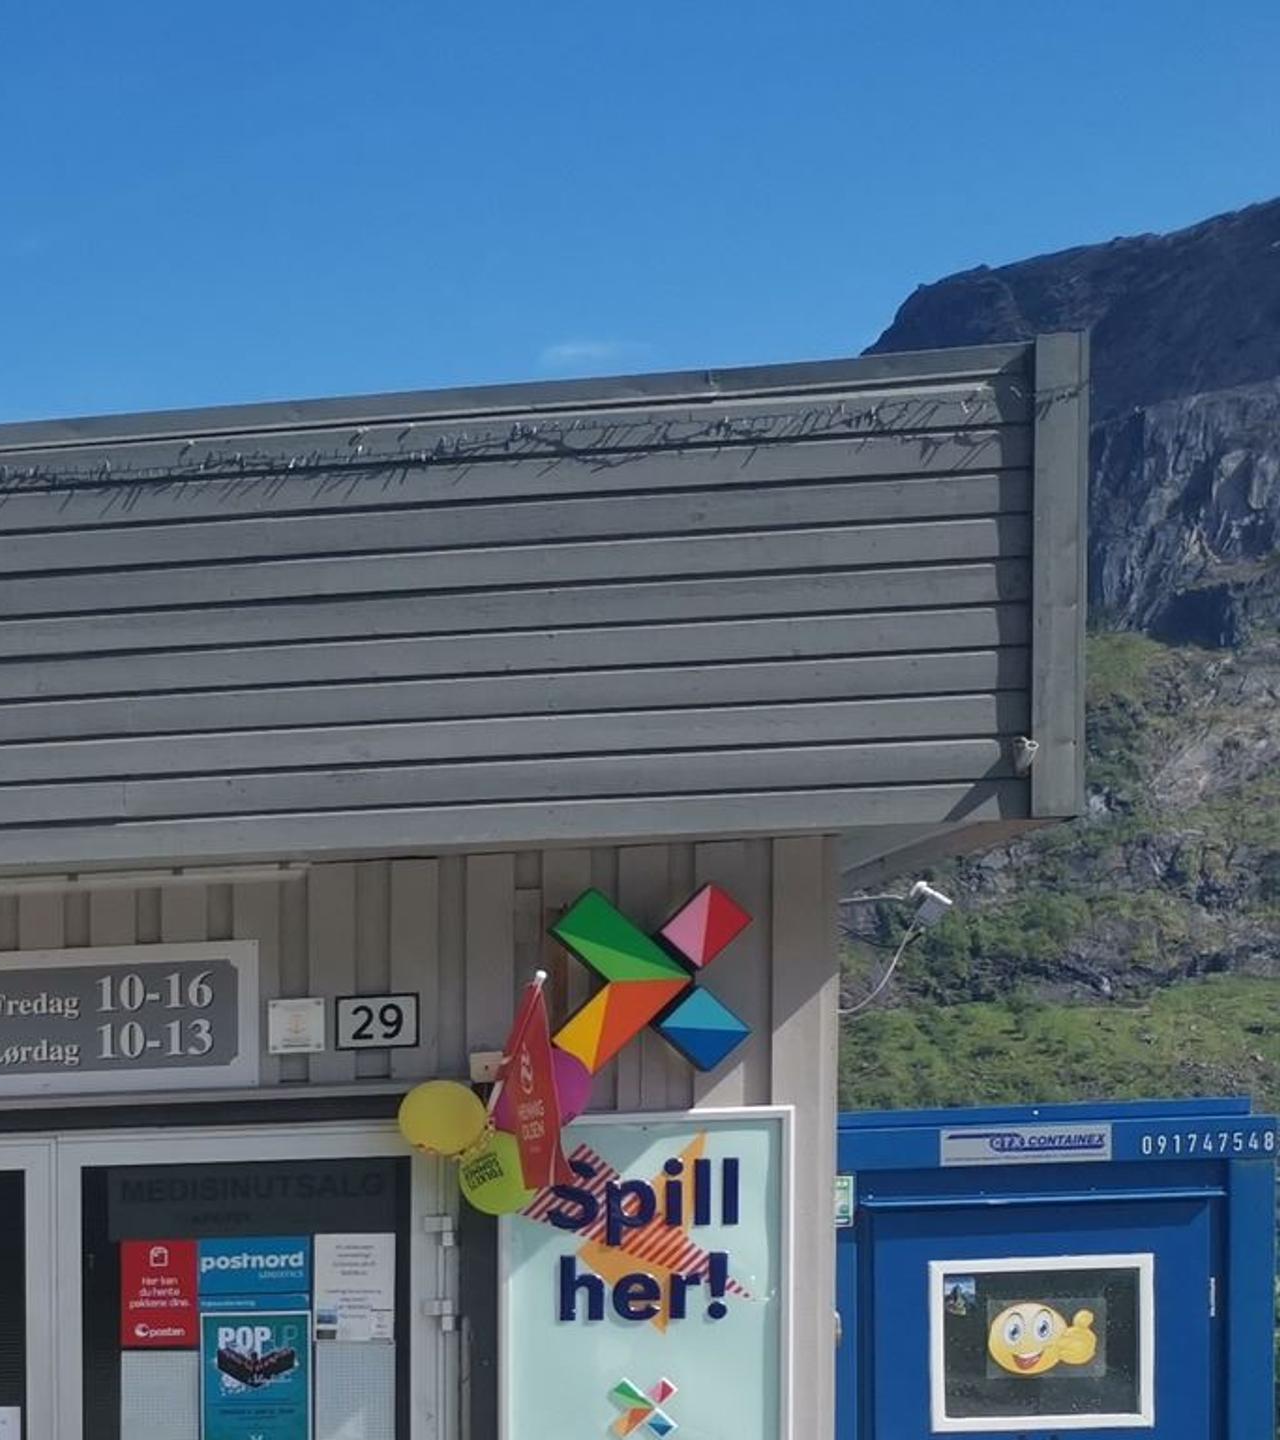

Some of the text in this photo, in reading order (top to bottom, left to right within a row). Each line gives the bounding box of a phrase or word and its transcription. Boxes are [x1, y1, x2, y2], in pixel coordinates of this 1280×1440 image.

[96, 970, 214, 1012] 10-16
[97, 1018, 214, 1059] 10-13
[351, 1003, 403, 1039] 29
[1025, 1133, 1106, 1147] CONTAINEX
[547, 1157, 739, 1246] Spill
[200, 1251, 304, 1273] postnord
[560, 1252, 728, 1321] her!
[149, 1327, 185, 1339] posten
[218, 1325, 272, 1352] POP
